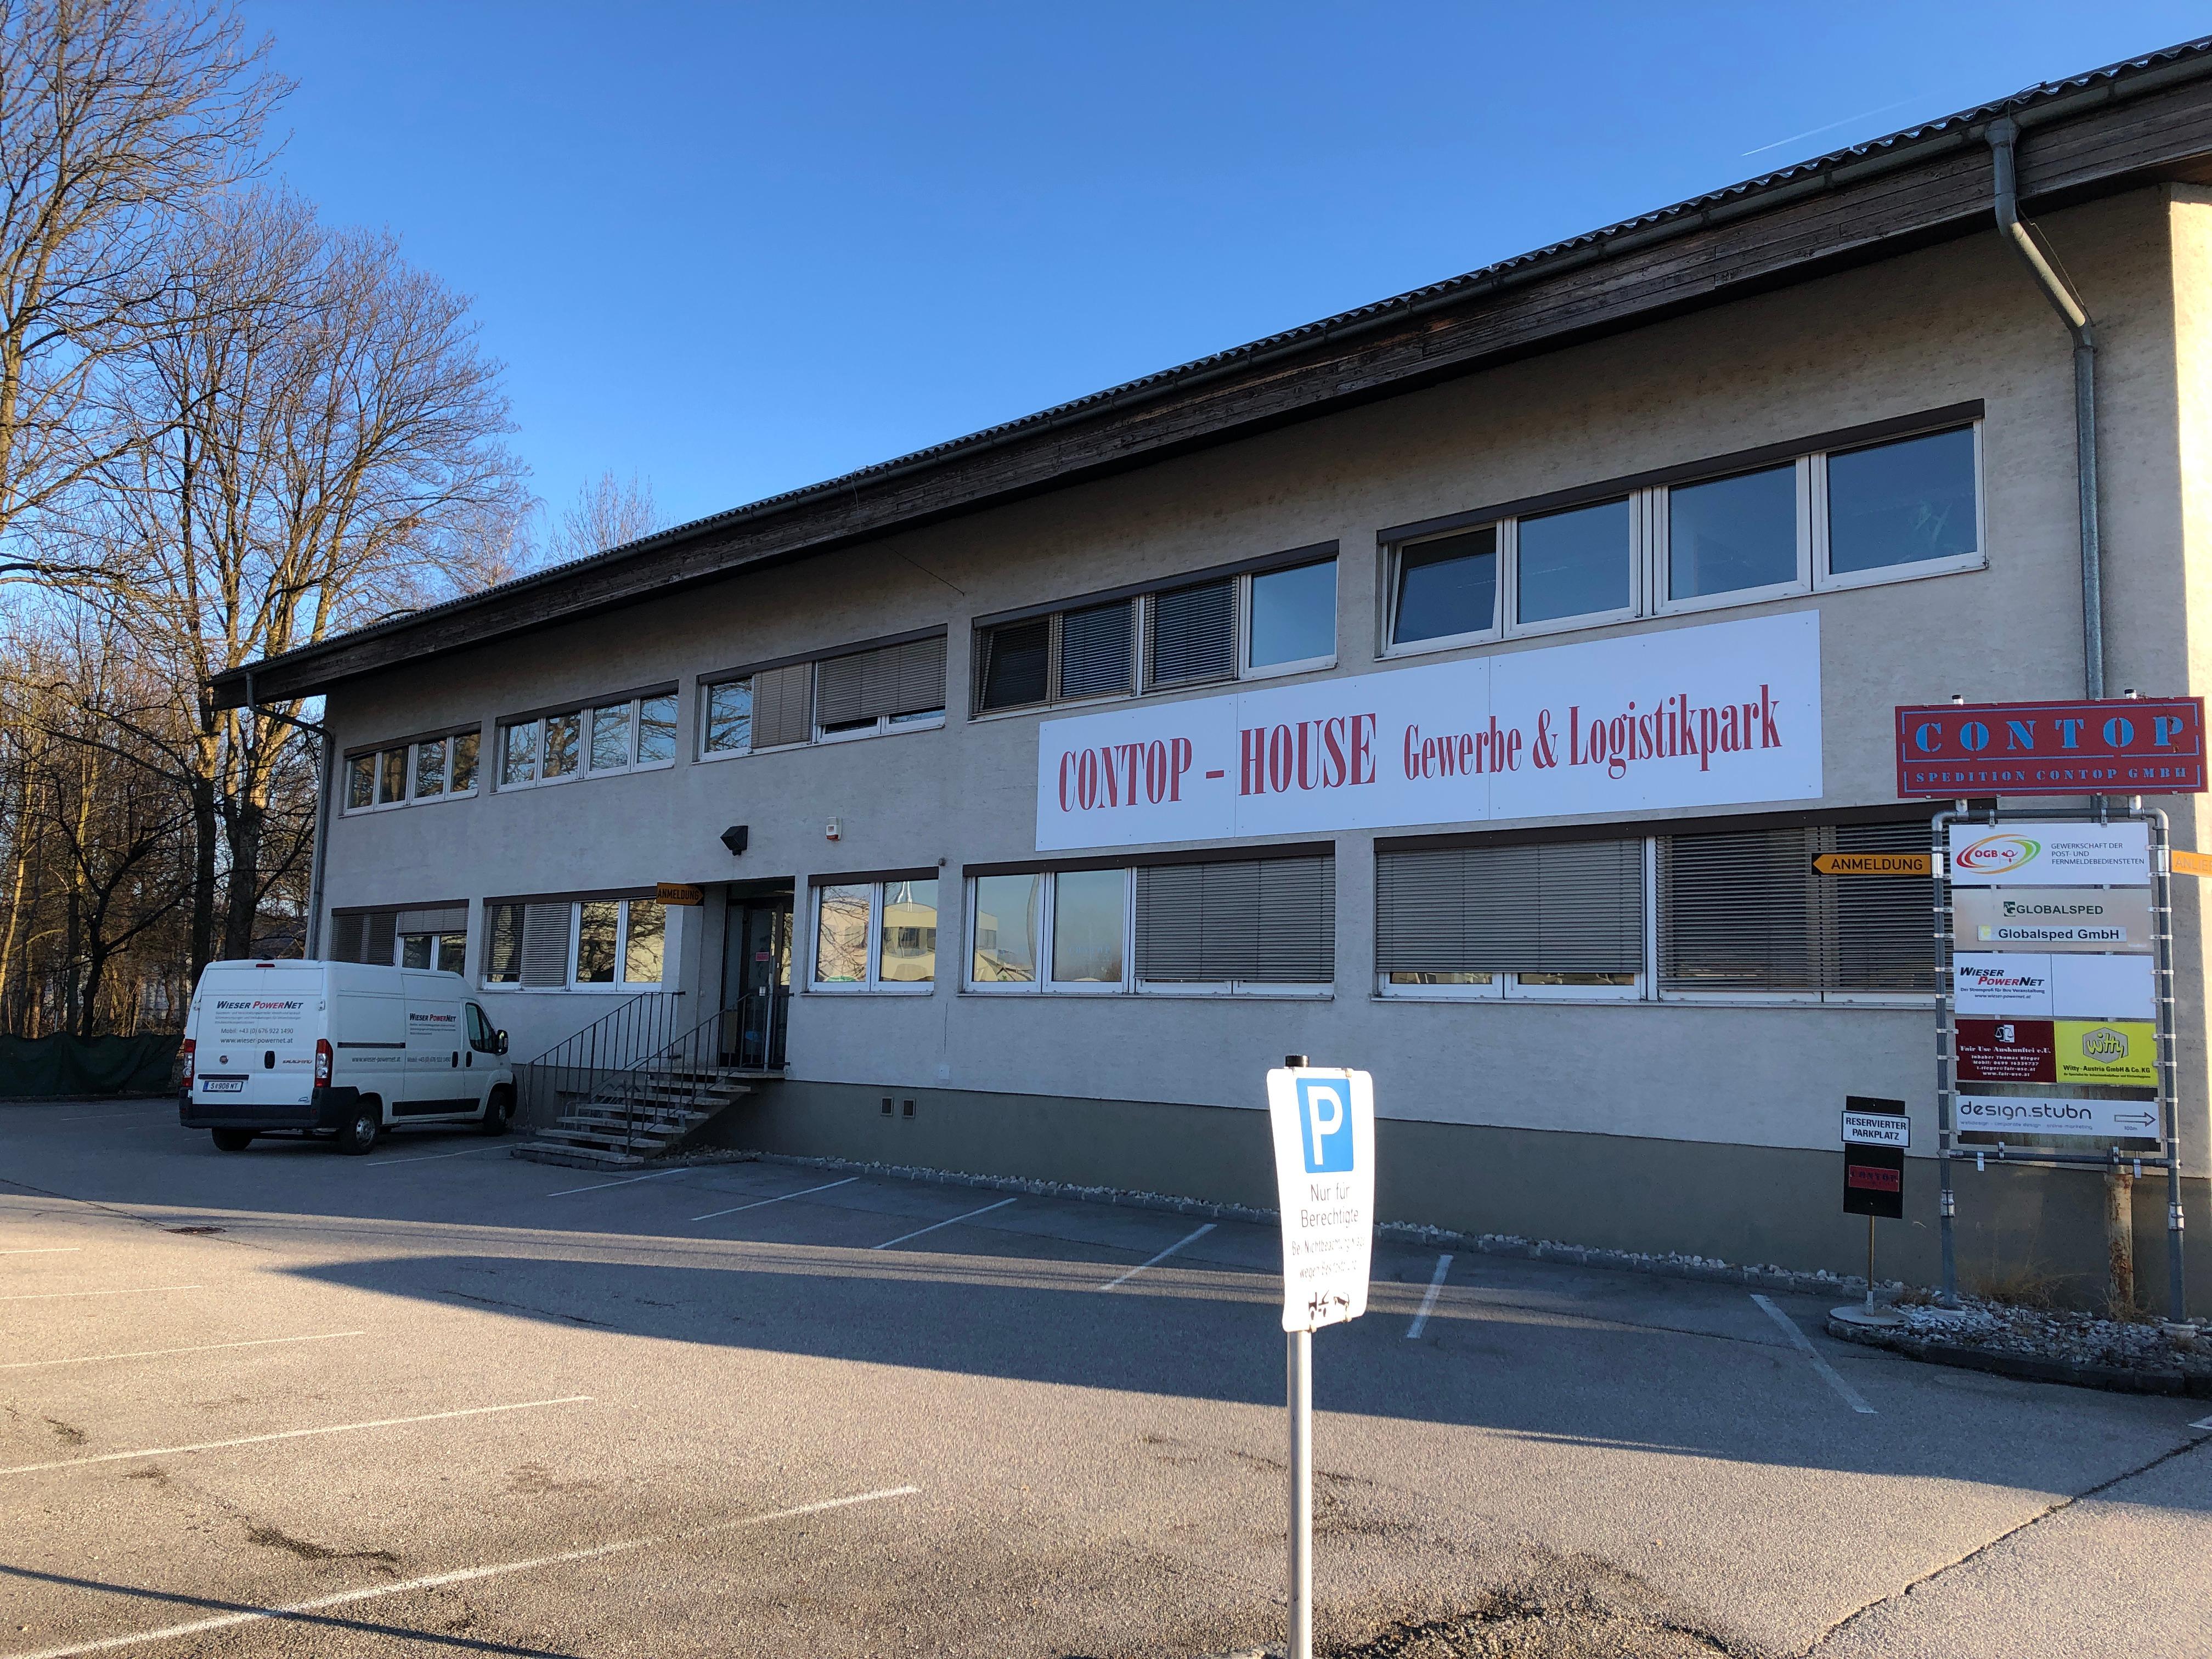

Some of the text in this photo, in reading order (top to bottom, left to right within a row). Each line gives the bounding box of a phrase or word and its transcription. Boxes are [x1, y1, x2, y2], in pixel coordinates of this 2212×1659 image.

[1915, 716, 2183, 753] CONTOP
[1059, 737, 1192, 812] CONTOP
[1238, 713, 1376, 795] HOUSE
[1404, 715, 1522, 780] Gewerbe
[1532, 709, 1559, 769] &
[1568, 684, 1782, 780] Logistikpark
[1916, 766, 2187, 783] SPEDITION CONTOP GMBH
[1831, 859, 1923, 870] ANMELDUNG
[658, 888, 699, 900] ANMELDUNG
[2016, 905, 2104, 915] GLOBALSPED
[1999, 928, 2119, 941] Globalsped GmbH
[2087, 1032, 2125, 1058] witty
[1960, 1101, 2092, 1120] design.stubn
[1307, 1086, 1344, 1165] P
[1846, 1117, 1906, 1130] RESERVIERTER
[1852, 1128, 1899, 1141] PARKPLATZ
[1311, 1183, 1331, 1202] Nur
[1301, 1206, 1358, 1228] Berechtigte
